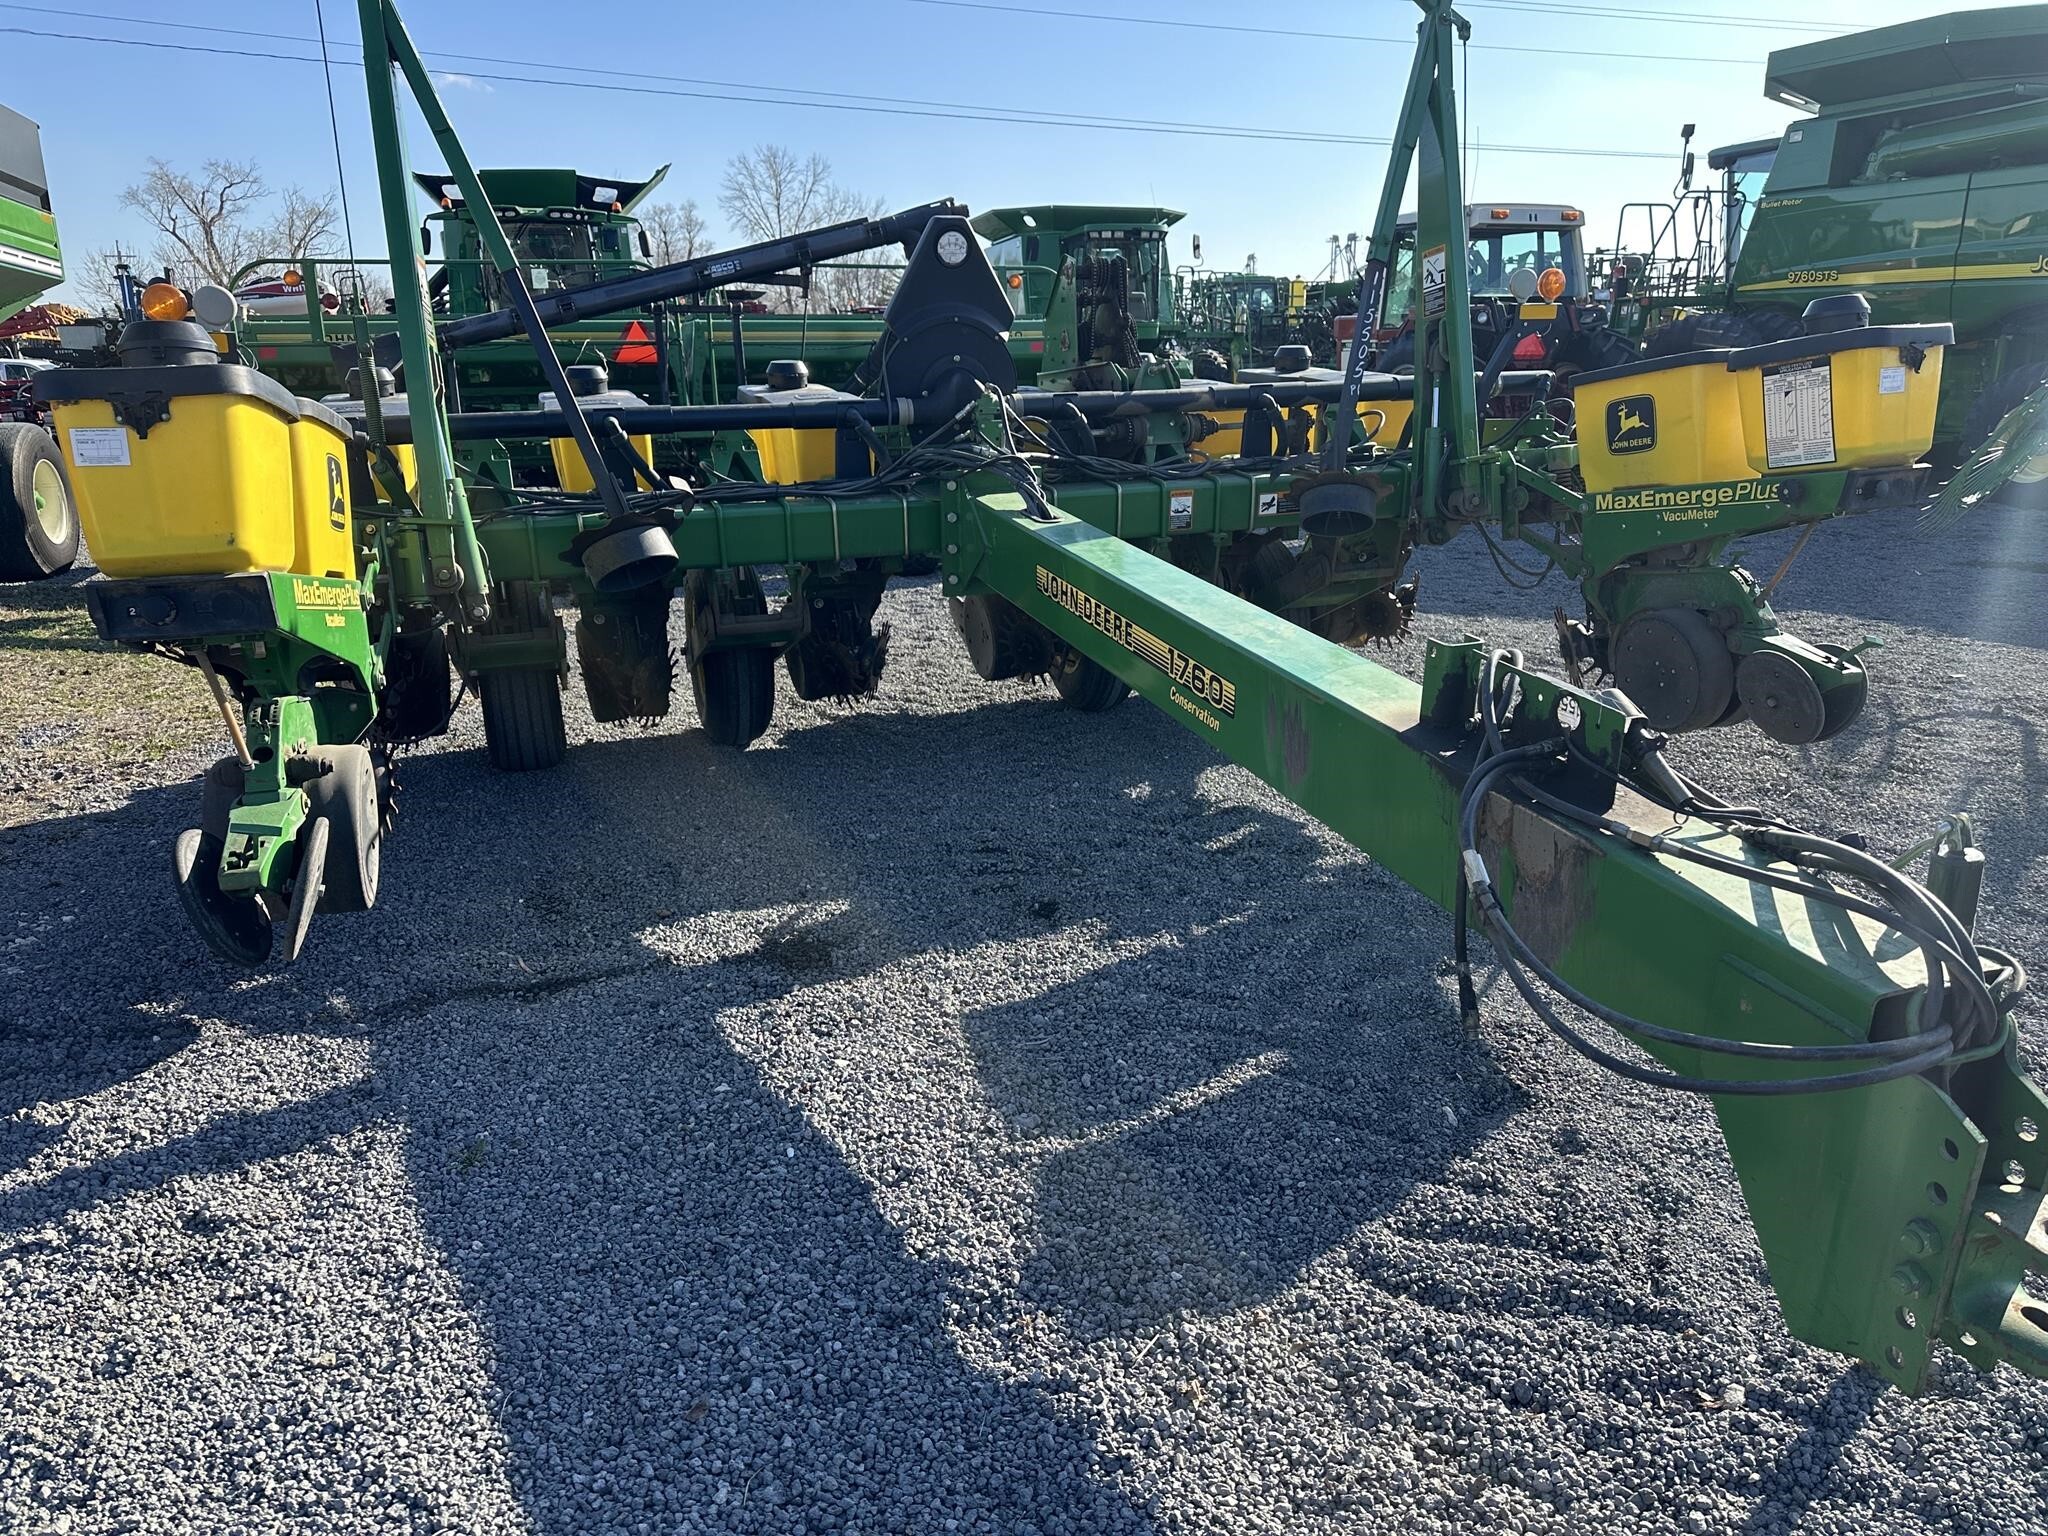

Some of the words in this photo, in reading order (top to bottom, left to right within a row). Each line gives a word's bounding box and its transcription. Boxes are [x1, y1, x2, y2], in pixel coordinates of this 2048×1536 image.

[1760, 200, 1781, 209] Bullet
[1781, 199, 1803, 207] Rotor
[1787, 270, 1839, 283] 9760STS
[1611, 441, 1629, 450] JOHN
[1629, 437, 1652, 447] DEERE
[1595, 481, 1780, 510] MaxEmergePlus
[1662, 508, 1719, 522] VacuMeter
[293, 578, 360, 611] MaxEmergePlus
[129, 607, 136, 616] 2
[1041, 571, 1080, 617] JOHN
[1083, 594, 1134, 652] DEERE
[1167, 645, 1225, 709] 1760
[1169, 685, 1220, 732] Conservation
